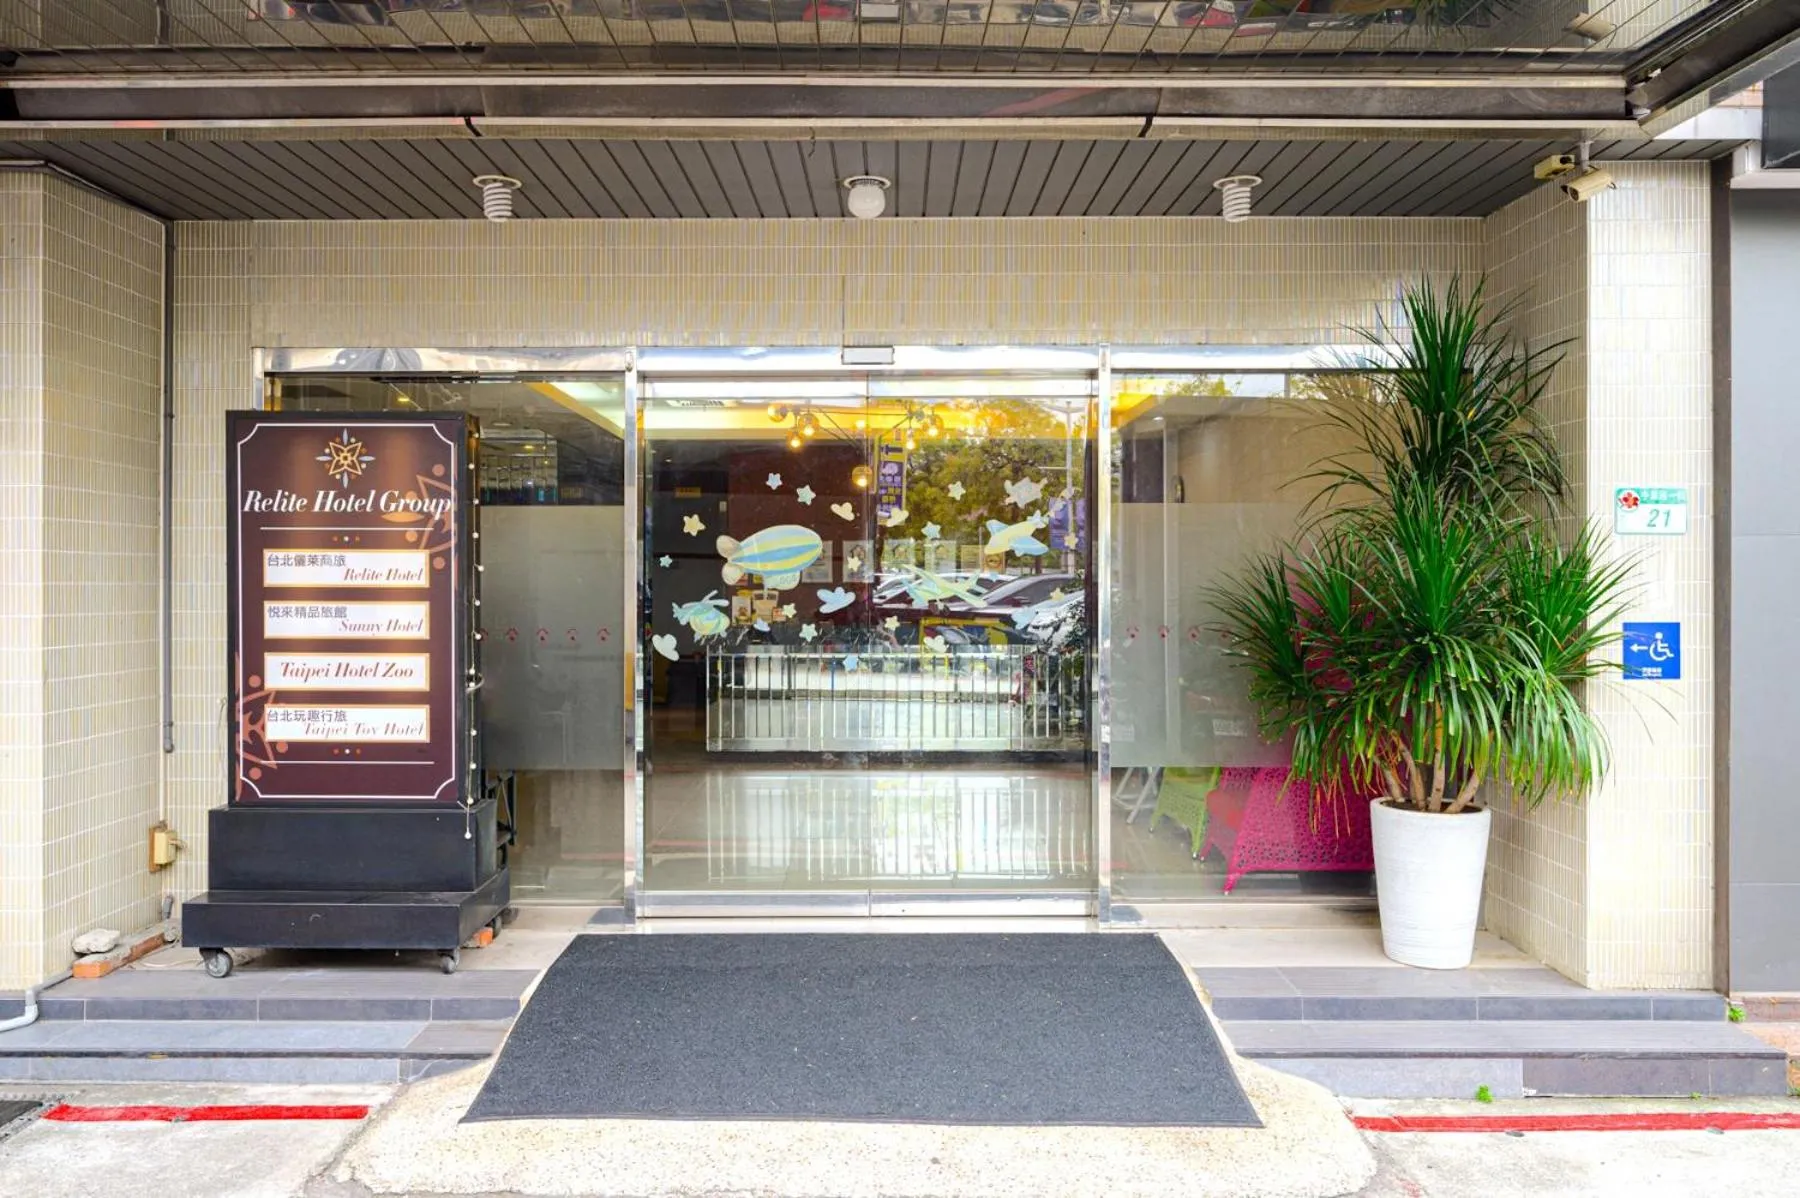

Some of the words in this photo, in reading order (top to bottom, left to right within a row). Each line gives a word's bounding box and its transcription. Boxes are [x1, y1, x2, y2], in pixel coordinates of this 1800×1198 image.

[243, 489, 308, 513] Relite
[311, 489, 376, 513] Hotel
[379, 489, 451, 521] Group
[1646, 508, 1672, 528] 21
[343, 567, 383, 581] Relite
[385, 567, 424, 581] Hotel
[339, 619, 383, 636] Sunny
[386, 618, 424, 632] Hotel
[281, 662, 331, 683] Taipei
[334, 661, 380, 678] Hotel
[382, 662, 414, 678] Zoo
[304, 723, 349, 739] Taipei
[384, 722, 424, 736] Hotel
